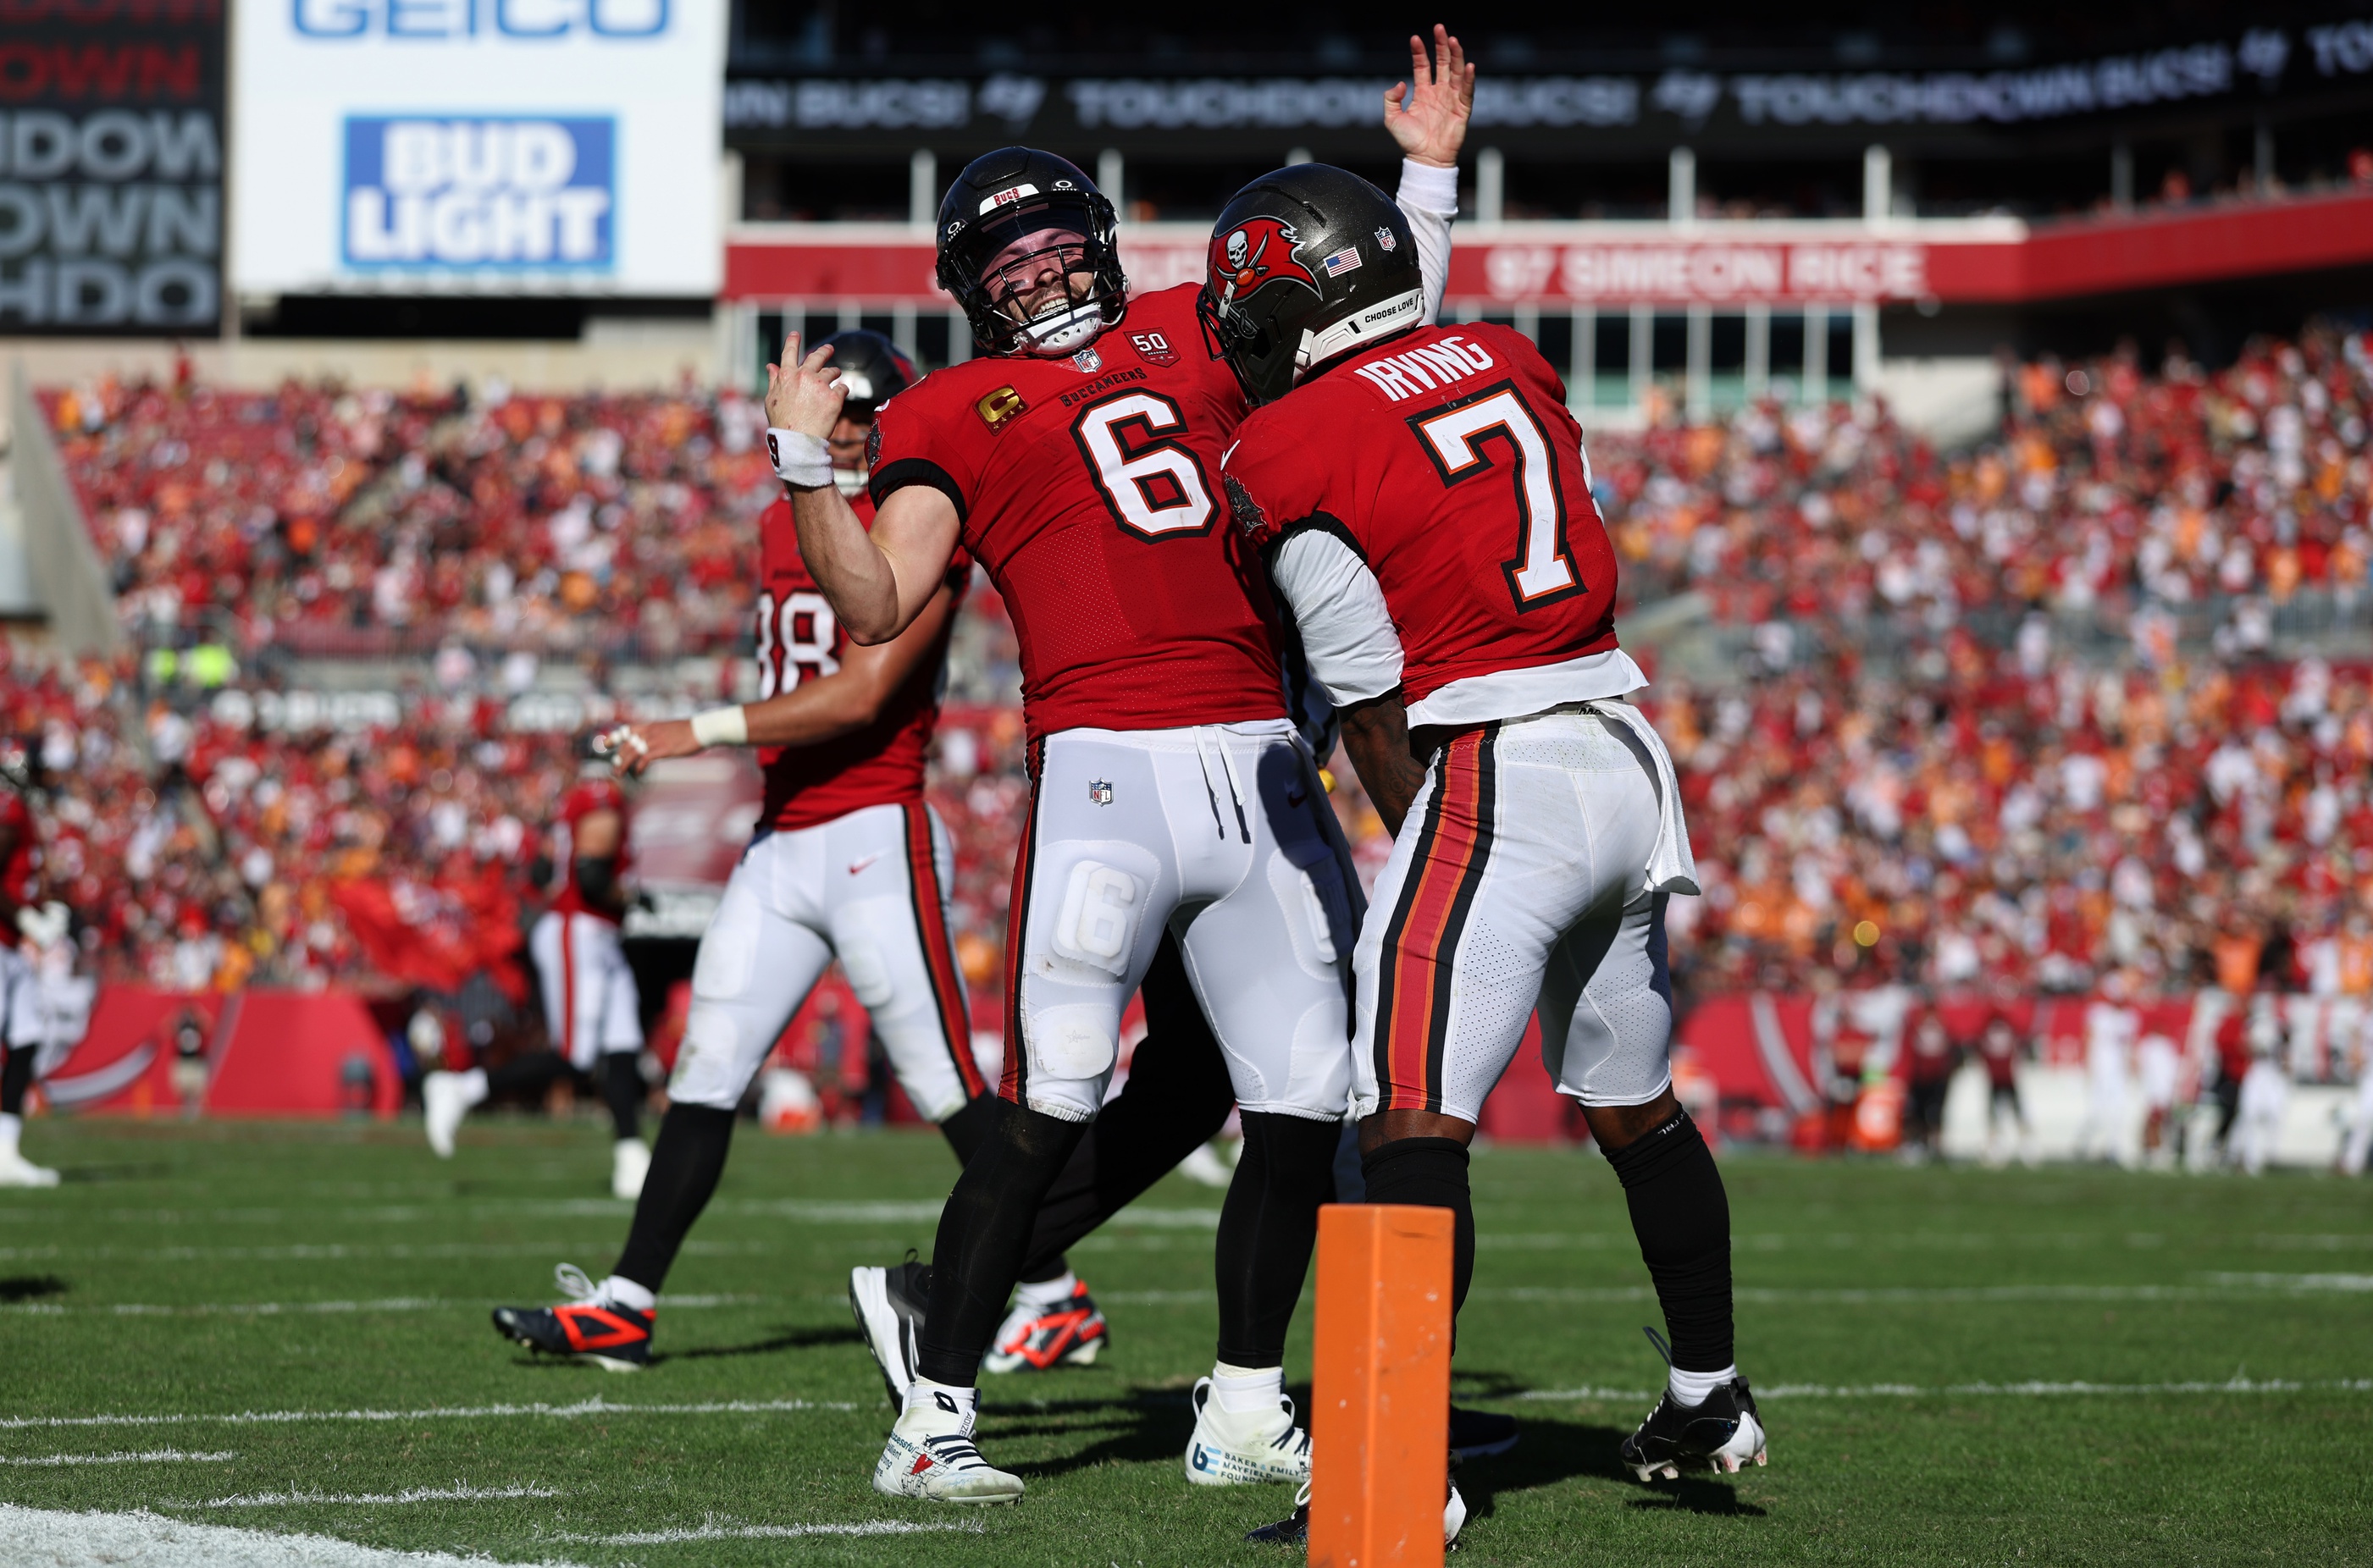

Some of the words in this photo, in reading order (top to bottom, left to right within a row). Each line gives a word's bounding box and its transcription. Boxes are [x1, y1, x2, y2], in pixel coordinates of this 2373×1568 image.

[292, 0, 670, 38] GEICO
[1065, 76, 1410, 129] TOUCHDOW
[382, 119, 578, 196] BUD
[993, 187, 1020, 207] BUCS
[347, 184, 612, 262] LIGHT
[1788, 246, 1924, 299] RICE
[1364, 306, 1397, 323] CHOOSE
[1397, 297, 1414, 312] LOVE
[1131, 333, 1169, 352] 50
[1081, 357, 1098, 369] NFL
[1353, 336, 1494, 401] IRVING
[978, 387, 1021, 422] C
[1059, 367, 1148, 406] BUCCANEERS
[1072, 388, 1220, 542] 6
[1412, 382, 1585, 609] 7
[1093, 789, 1109, 802] NFL
[1065, 862, 1136, 959] 6
[1223, 1461, 1273, 1479] MAYFIELD
[1225, 1452, 1258, 1468] BAKER
[1270, 1466, 1301, 1477] EMILY
